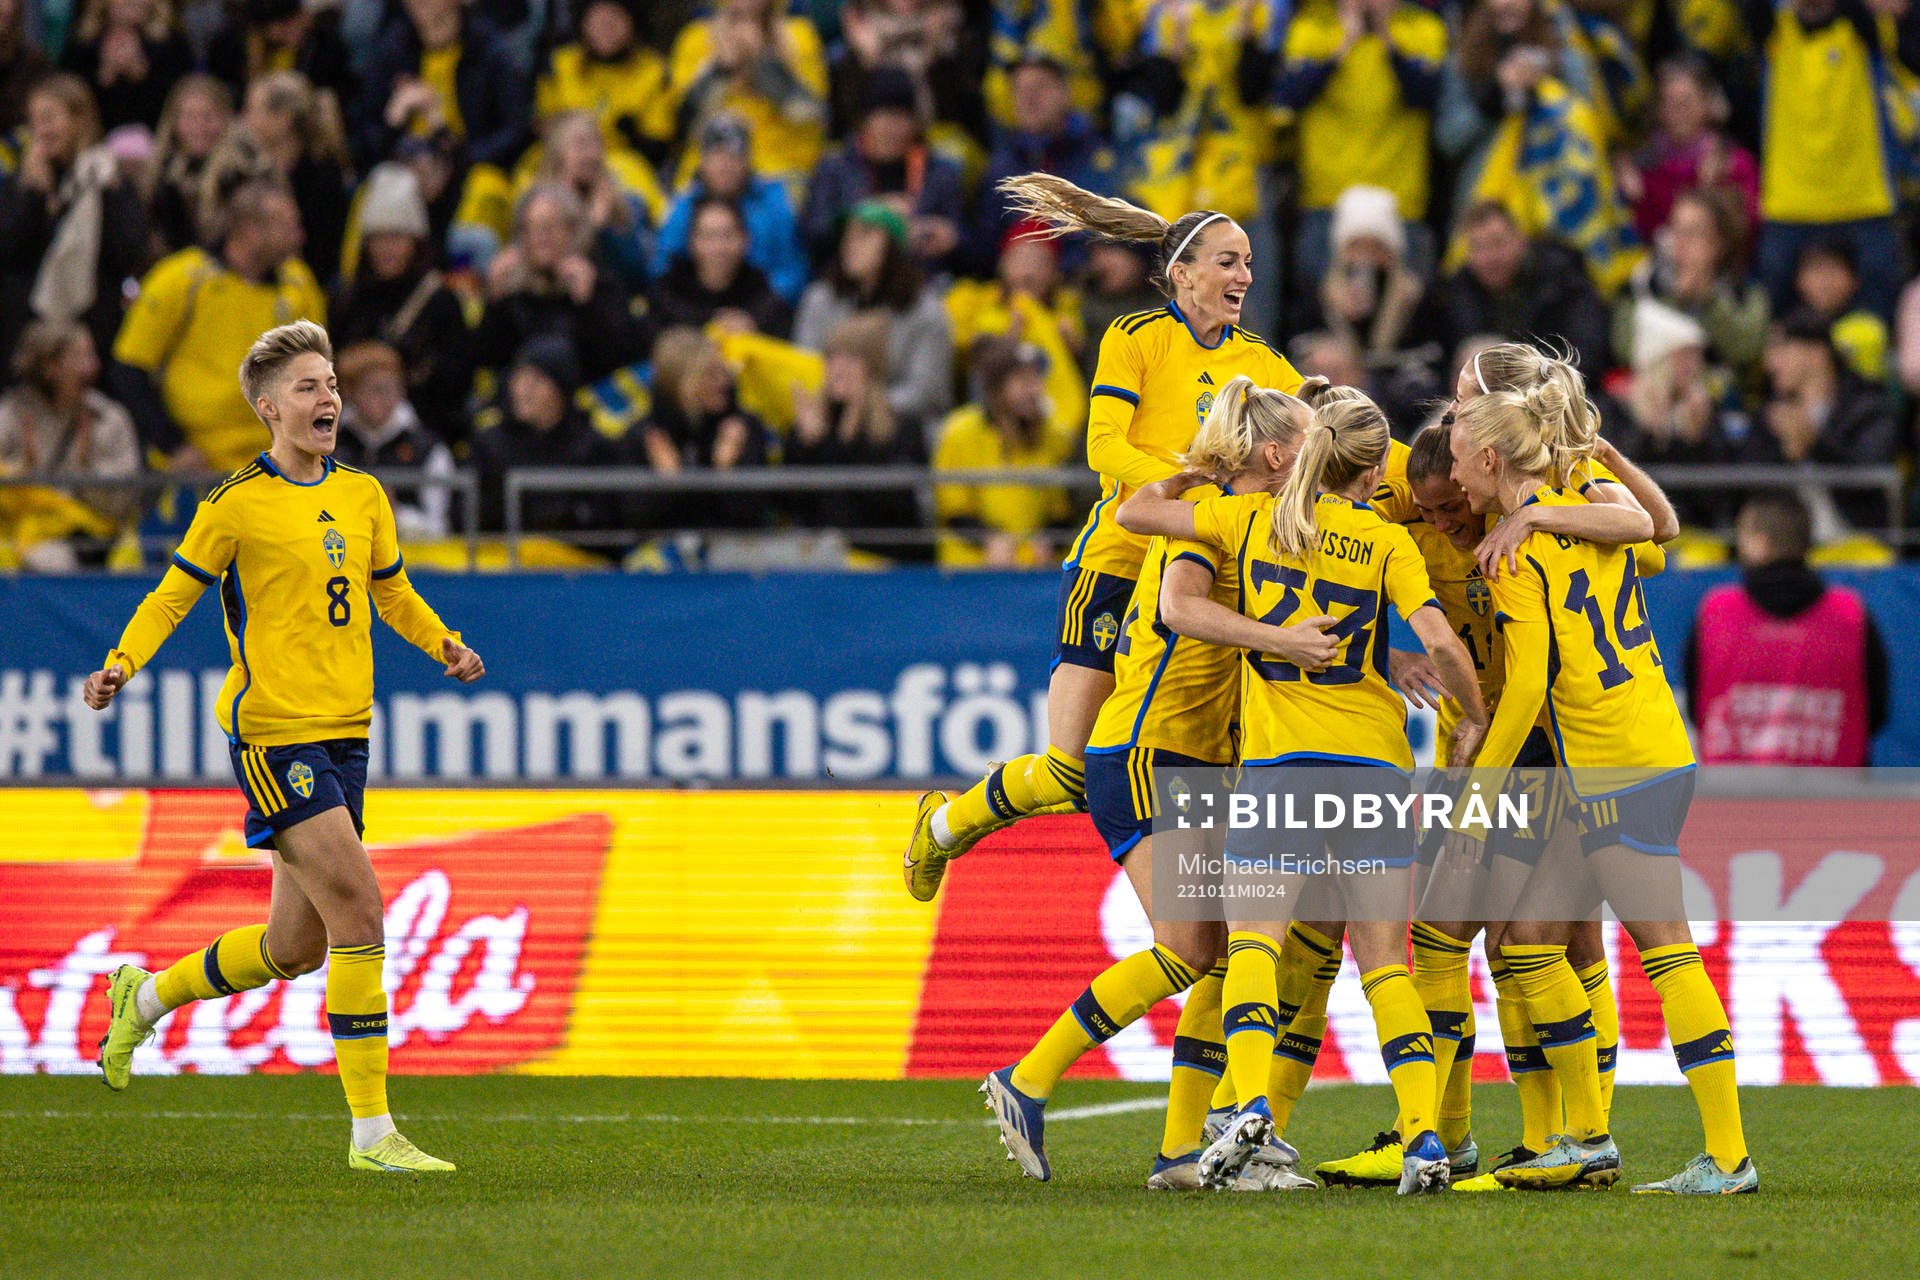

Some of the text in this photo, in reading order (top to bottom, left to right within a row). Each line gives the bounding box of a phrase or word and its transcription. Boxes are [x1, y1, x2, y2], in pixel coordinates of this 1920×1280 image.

[326, 575, 351, 628] 8
[1246, 558, 1378, 686] 23
[1563, 546, 1663, 691] 14
